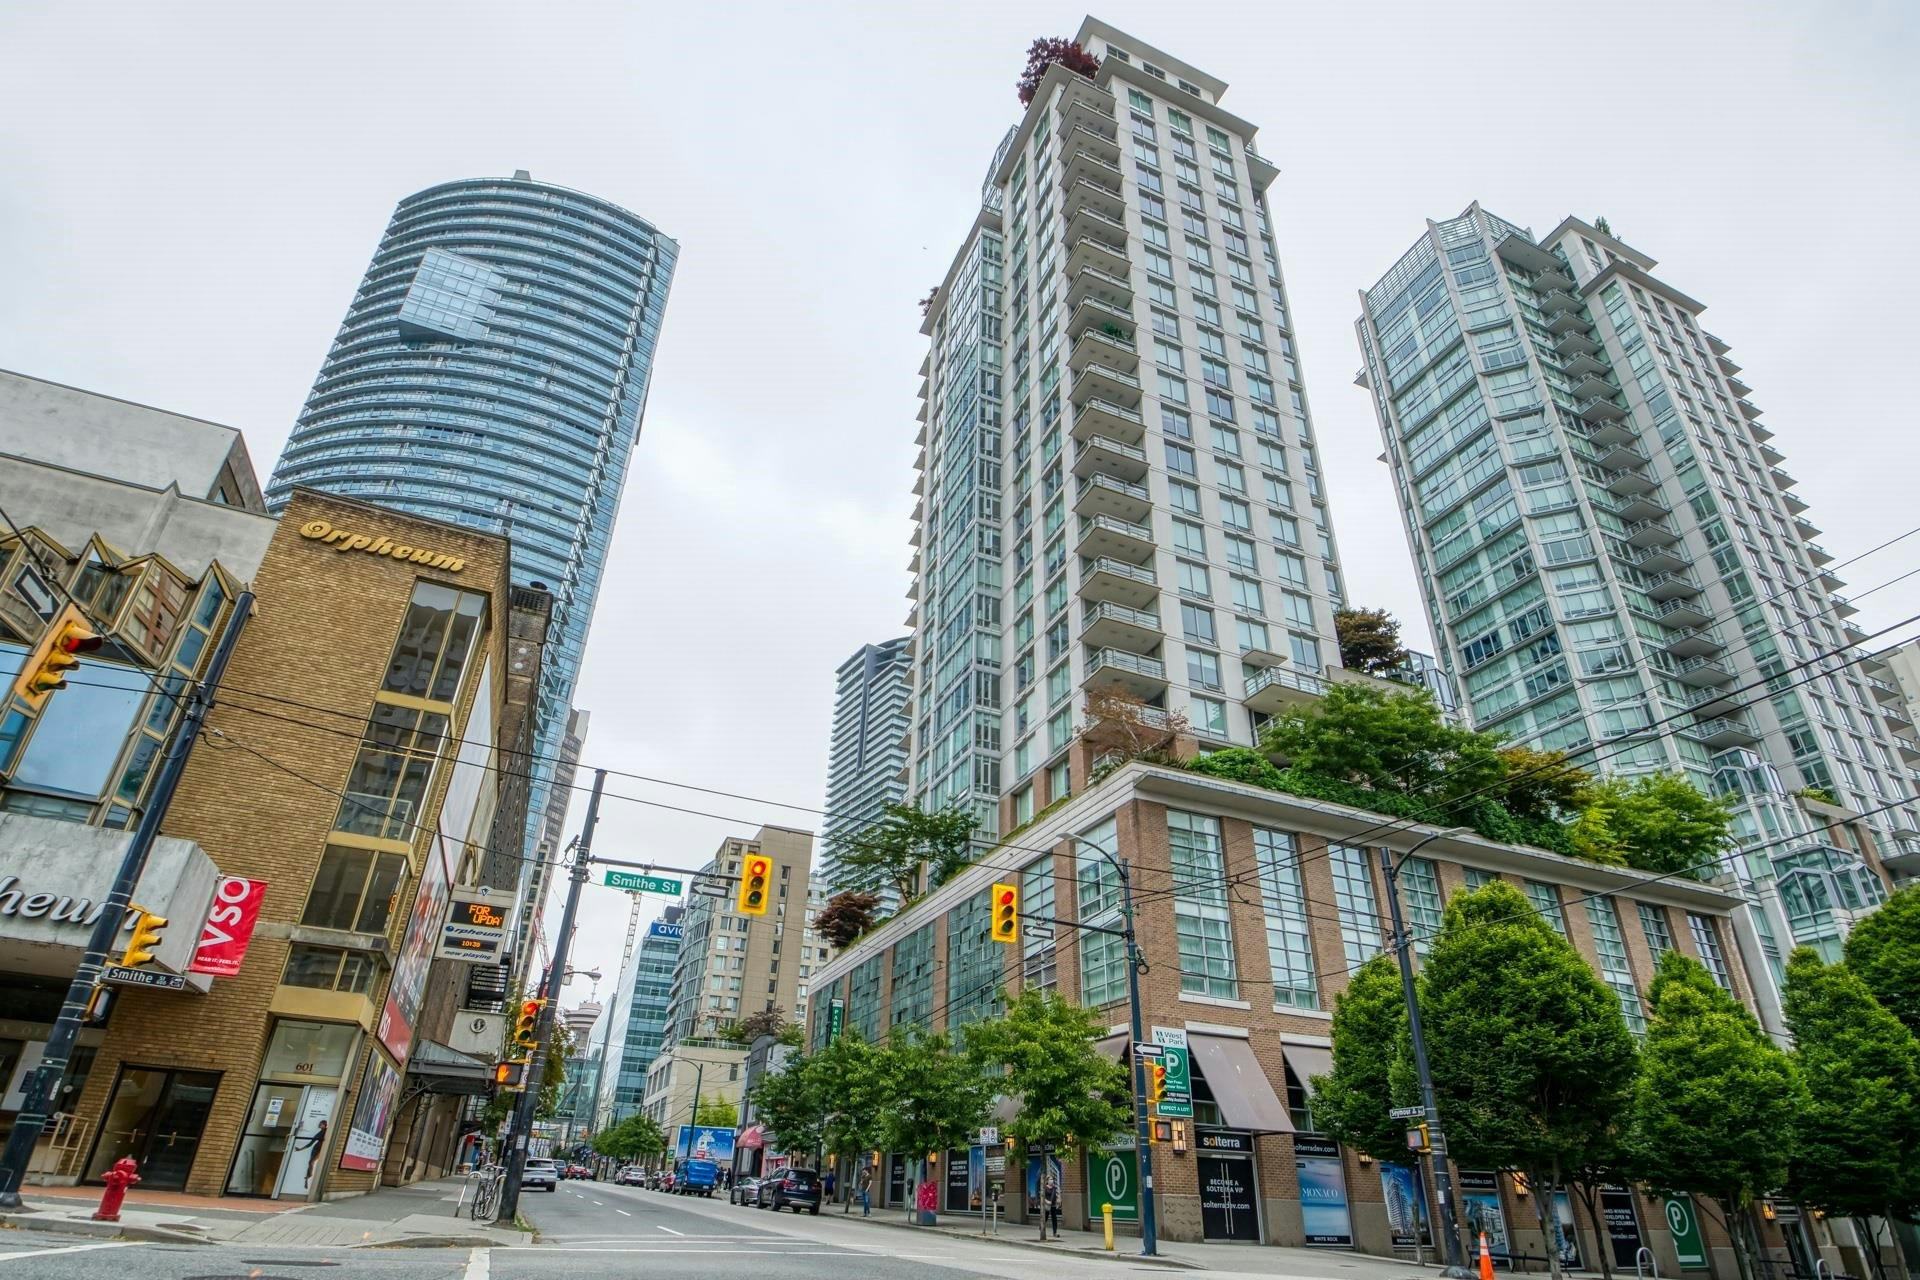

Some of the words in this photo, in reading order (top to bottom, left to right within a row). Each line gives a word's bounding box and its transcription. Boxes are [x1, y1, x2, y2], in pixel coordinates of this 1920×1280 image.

[300, 520, 466, 572] Orpheum
[611, 874, 656, 890] Smithe
[661, 881, 676, 893] St
[200, 877, 251, 948] VSO
[469, 904, 490, 915] FOR
[473, 914, 502, 926] UPDA
[445, 926, 503, 938] Orpheum
[462, 952, 492, 960] playing
[111, 969, 153, 984] Smithe
[1164, 1031, 1182, 1040] West
[296, 1063, 313, 1072] 601
[1166, 1053, 1179, 1073] P
[1203, 1137, 1240, 1148] solterra
[1295, 1143, 1336, 1153] olterradev.com
[1111, 1165, 1121, 1192] P
[1302, 1187, 1338, 1198] MONACO
[1671, 1207, 1681, 1230] P
